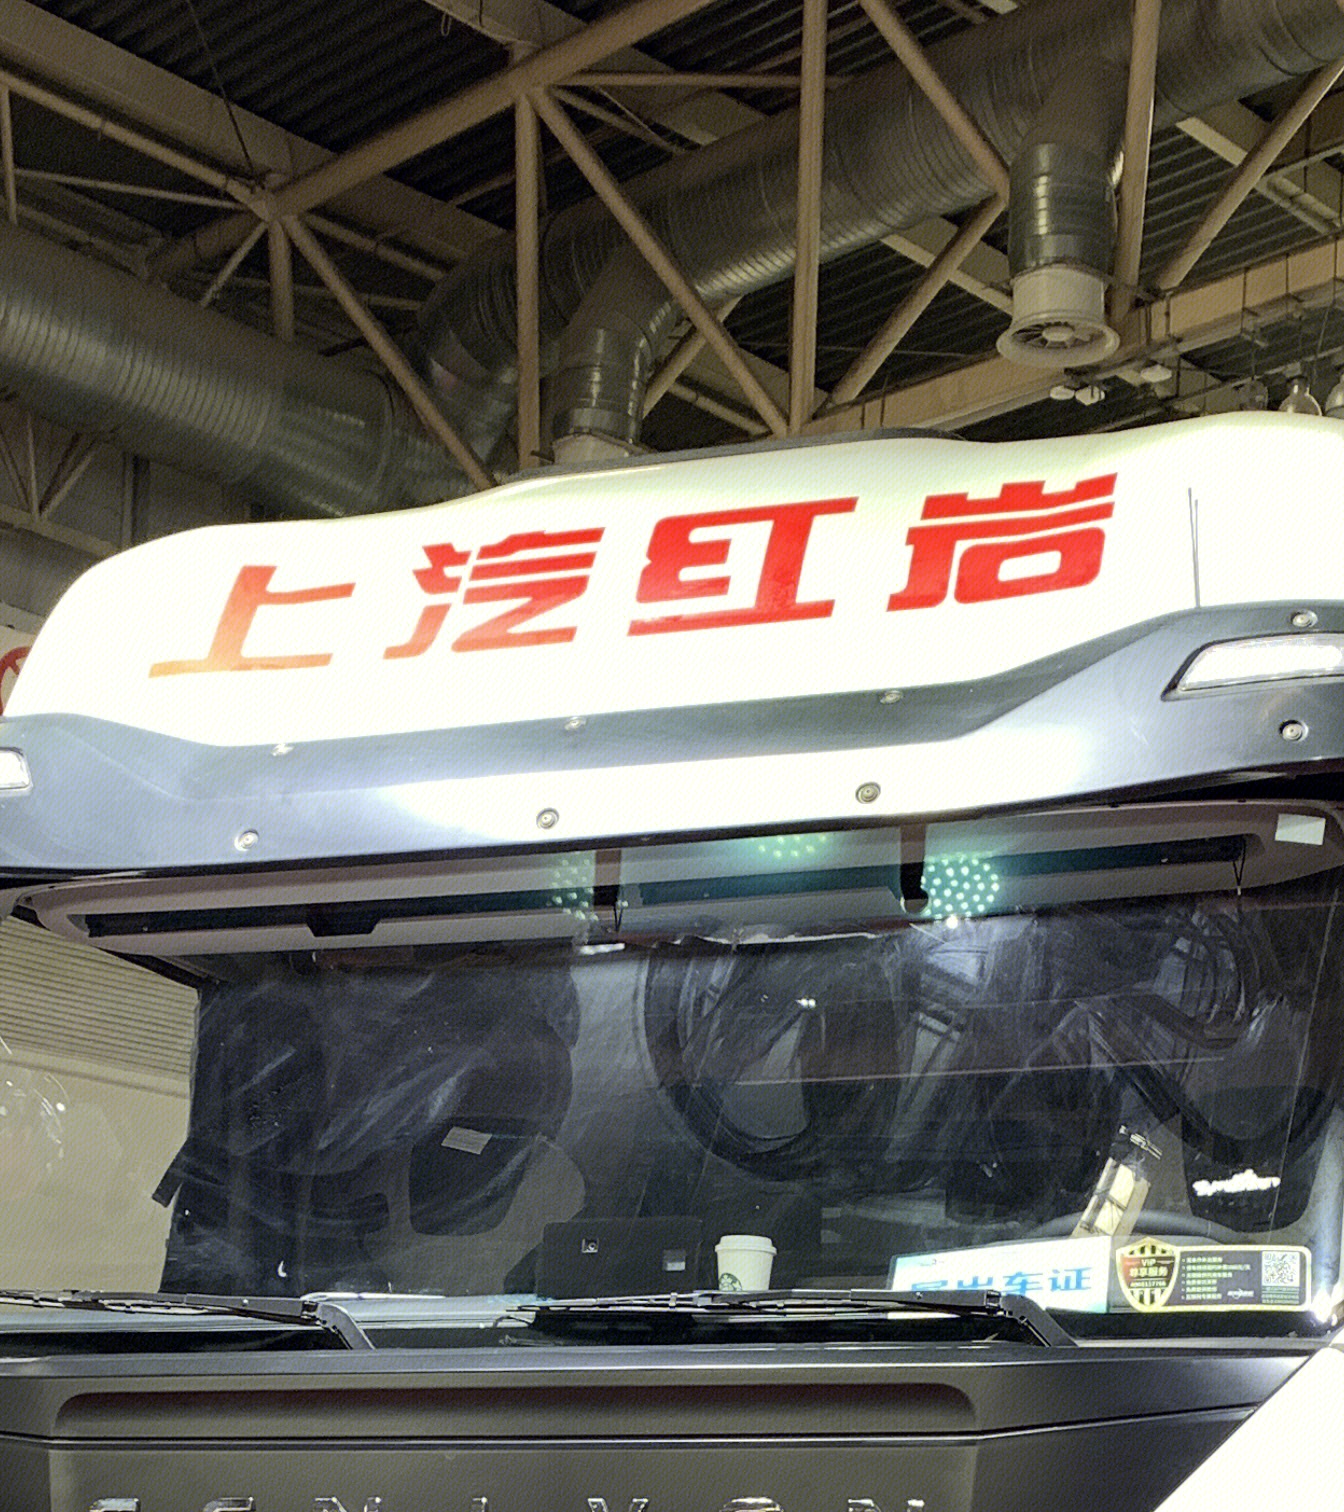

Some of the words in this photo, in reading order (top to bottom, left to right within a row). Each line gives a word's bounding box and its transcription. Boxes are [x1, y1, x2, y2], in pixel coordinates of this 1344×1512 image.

[147, 472, 1118, 678] 上汽红岩
[1141, 1258, 1156, 1267] VIP
